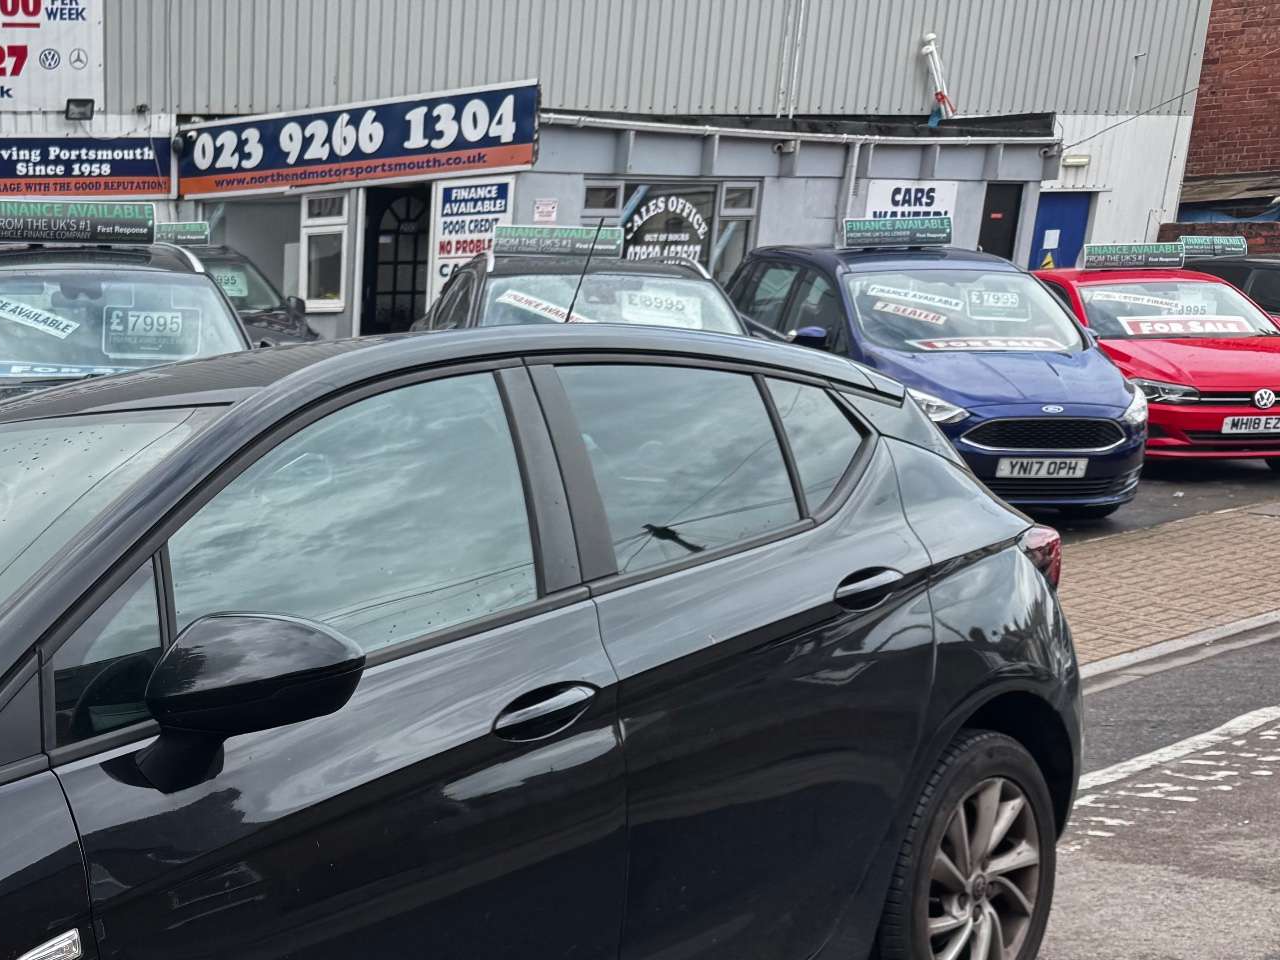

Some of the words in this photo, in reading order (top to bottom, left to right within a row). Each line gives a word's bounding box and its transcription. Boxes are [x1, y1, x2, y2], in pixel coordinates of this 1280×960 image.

[45, 7, 86, 21] WEEK
[193, 128, 264, 171] 023
[279, 110, 385, 166] 9266
[404, 94, 516, 150] 1304
[48, 146, 155, 161] Portsmouth
[16, 163, 65, 176] Since
[71, 163, 111, 176] 1958
[214, 152, 487, 188] www.northendmotorsportsmouth.co.uk
[25, 182, 51, 192] WITH
[54, 182, 72, 192] THE
[74, 181, 102, 191] GOOD
[104, 180, 167, 191] REPUTATION!
[451, 185, 498, 200] FINANCE
[890, 187, 936, 207] CARS
[67, 204, 153, 219] AVAILABLE
[442, 200, 505, 215] AVAILABLE!
[26, 219, 48, 231] THE
[51, 219, 77, 231] UK'S
[79, 219, 91, 231] #1
[667, 196, 709, 240] OFFICE
[846, 221, 893, 231] FINANCE
[895, 218, 950, 230] AVAILABLE
[24, 230, 50, 239] FINANCE
[51, 231, 91, 240] COMPANY
[97, 225, 112, 233] First
[114, 226, 148, 234] Response
[442, 220, 466, 235] POOR
[496, 228, 551, 238] FINANCE
[439, 240, 451, 256] NO
[454, 238, 493, 255] PROBLE
[1087, 245, 1129, 254] FINANCE
[1131, 243, 1183, 254] AVAILABLE
[1107, 254, 1119, 262] THE
[8, 304, 72, 334] AVAILABLE
[110, 310, 180, 333] £7995
[1139, 321, 1184, 333] FOR
[1186, 320, 1239, 333] SALE
[1230, 417, 1261, 430] MH18
[1009, 460, 1045, 475] YN17
[1047, 461, 1078, 476] OPH
